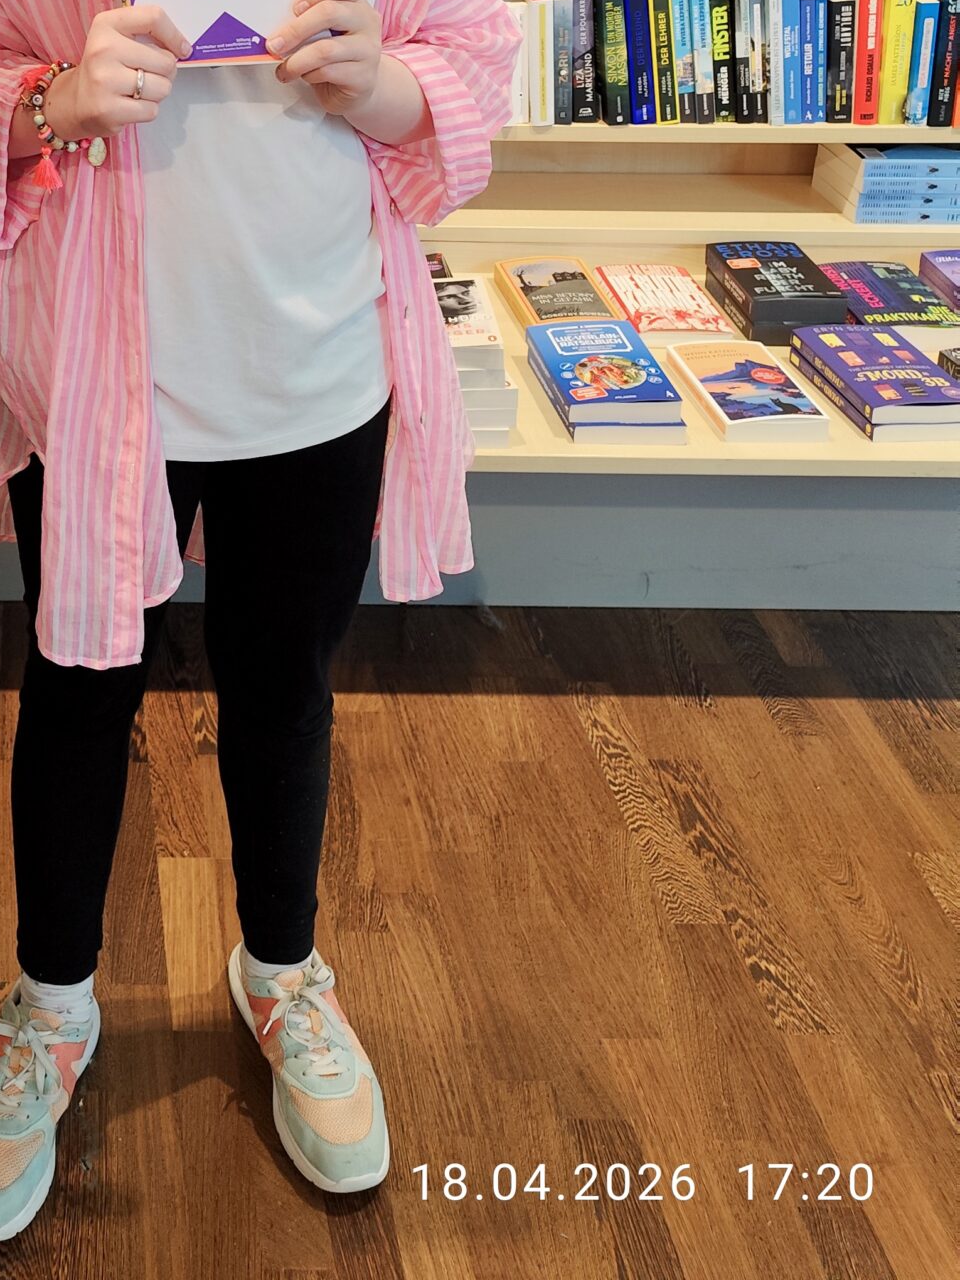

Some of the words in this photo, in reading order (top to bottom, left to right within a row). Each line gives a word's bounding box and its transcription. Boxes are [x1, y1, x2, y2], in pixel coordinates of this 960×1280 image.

[579, 30, 587, 45] DER
[658, 12, 668, 46] LEHRER
[712, 5, 729, 61] FINSTER
[660, 46, 669, 66] DER
[576, 68, 585, 89] LIZA
[585, 52, 594, 102] MARKLUND
[720, 66, 730, 105] MENGER
[715, 243, 798, 253] ETHAN
[722, 250, 804, 259] CROSS
